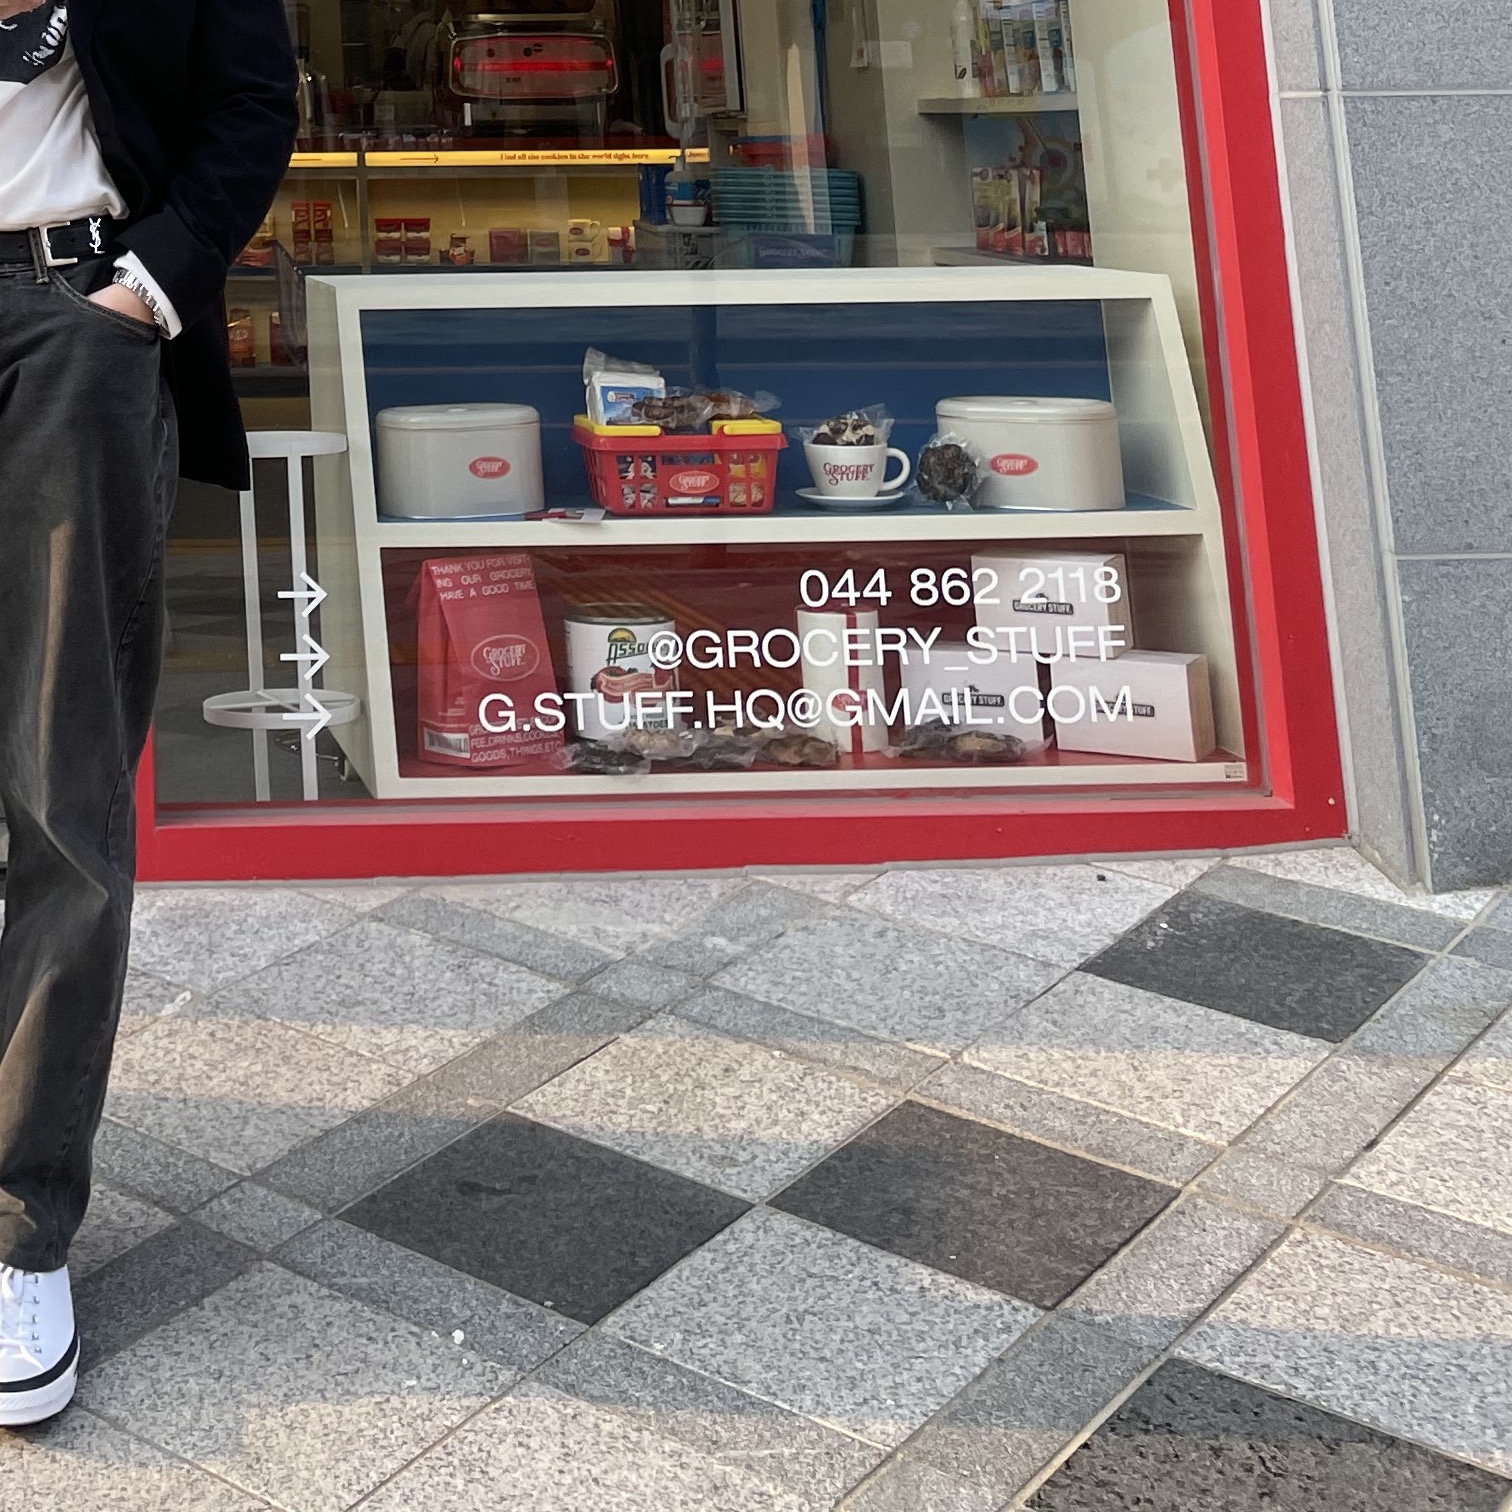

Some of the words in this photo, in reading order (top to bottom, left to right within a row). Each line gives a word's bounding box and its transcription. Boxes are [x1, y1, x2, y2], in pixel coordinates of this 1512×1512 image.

[800, 568, 893, 607] 044
[909, 567, 1000, 606] 862
[1018, 566, 1122, 604] 2118
[647, 626, 1126, 670] @GROCERY_STUFF
[477, 685, 1134, 733] G.STUFF.HQ@GMAIL.COM
